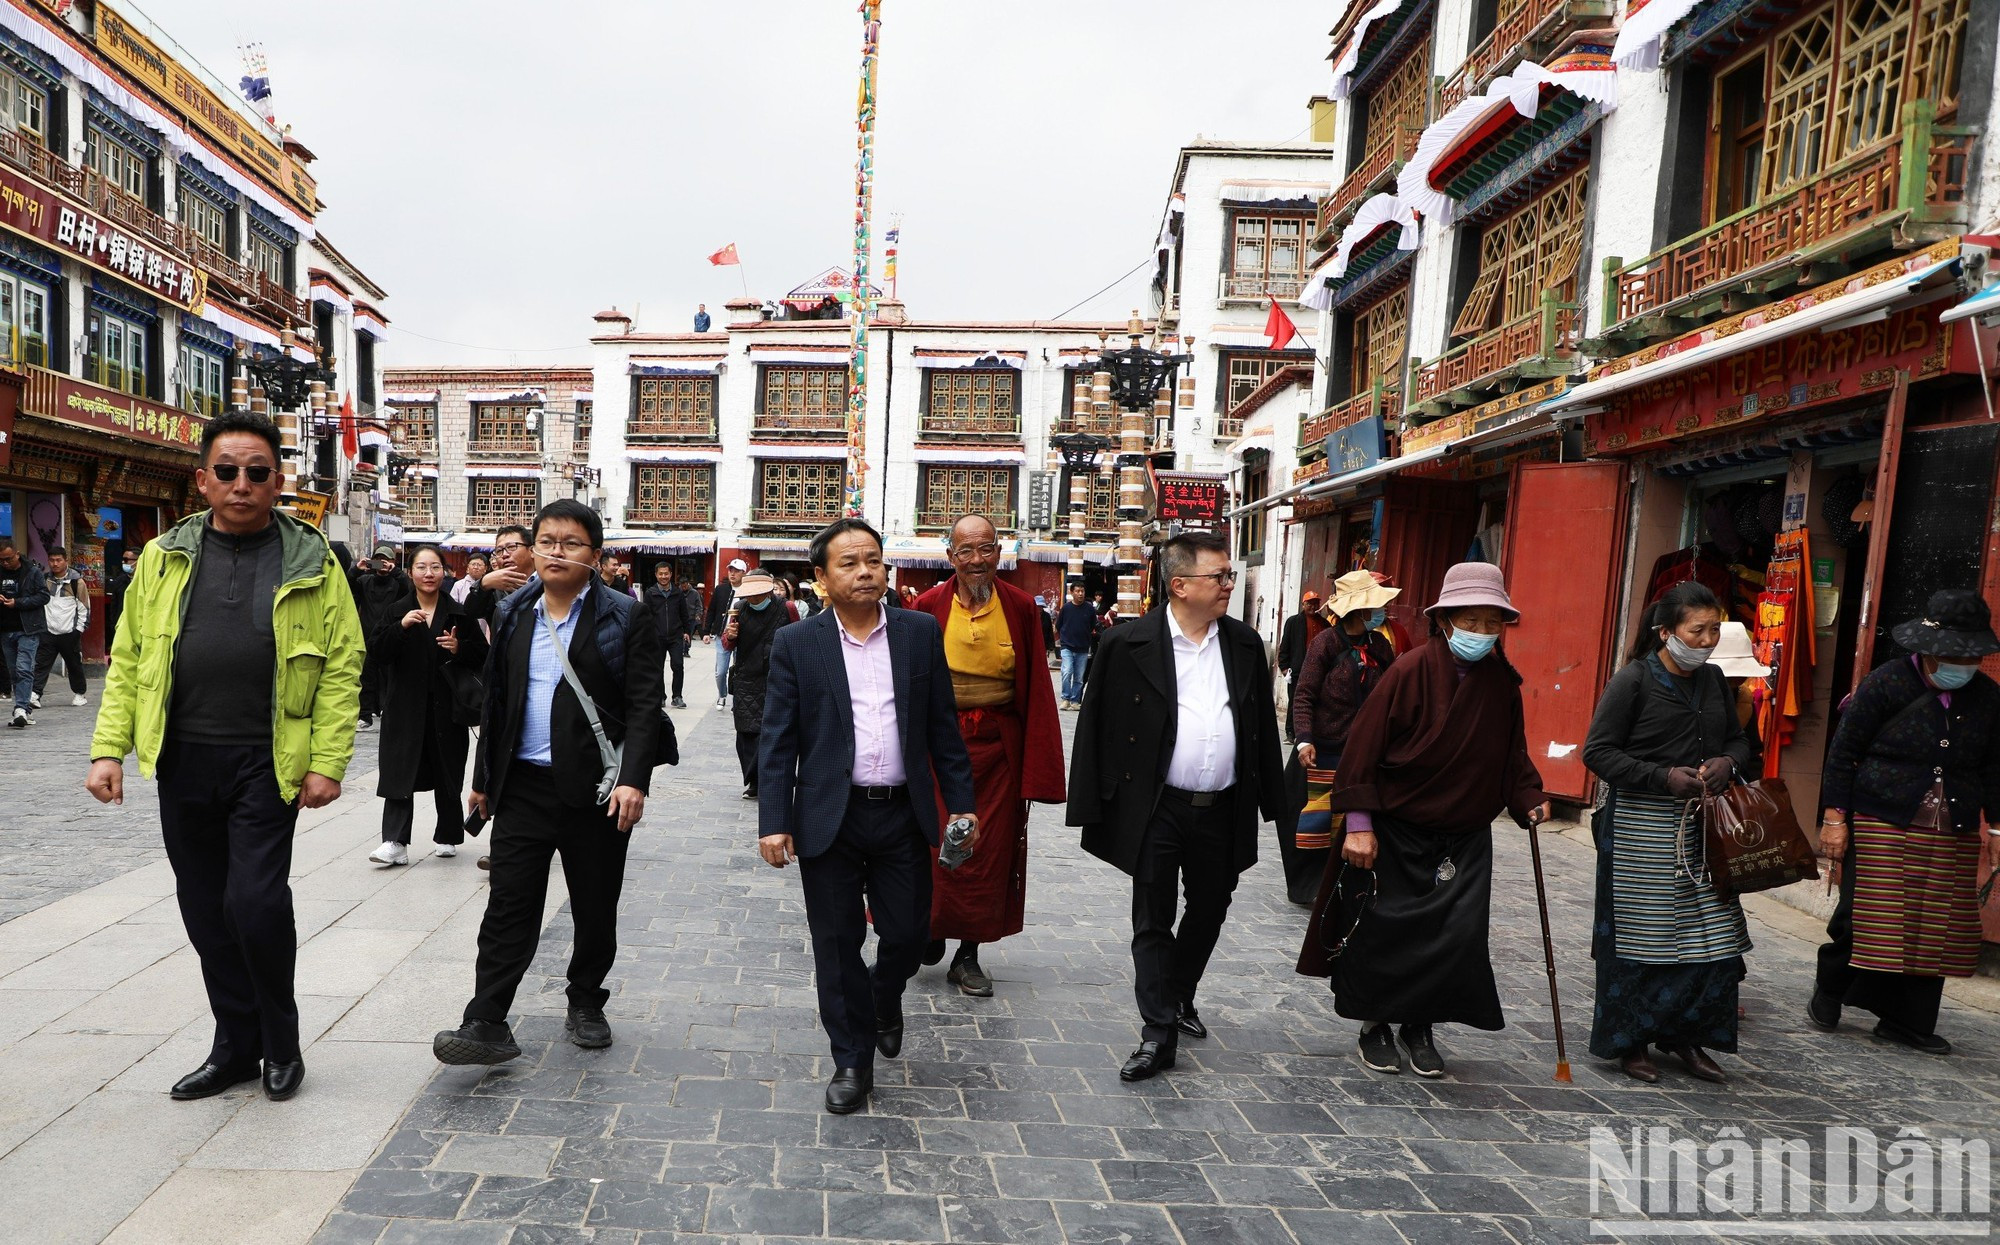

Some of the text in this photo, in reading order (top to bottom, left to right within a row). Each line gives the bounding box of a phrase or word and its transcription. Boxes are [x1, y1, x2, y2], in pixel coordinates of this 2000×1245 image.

[1164, 485, 1217, 499] 安全出口
[1163, 507, 1179, 517] Exit
